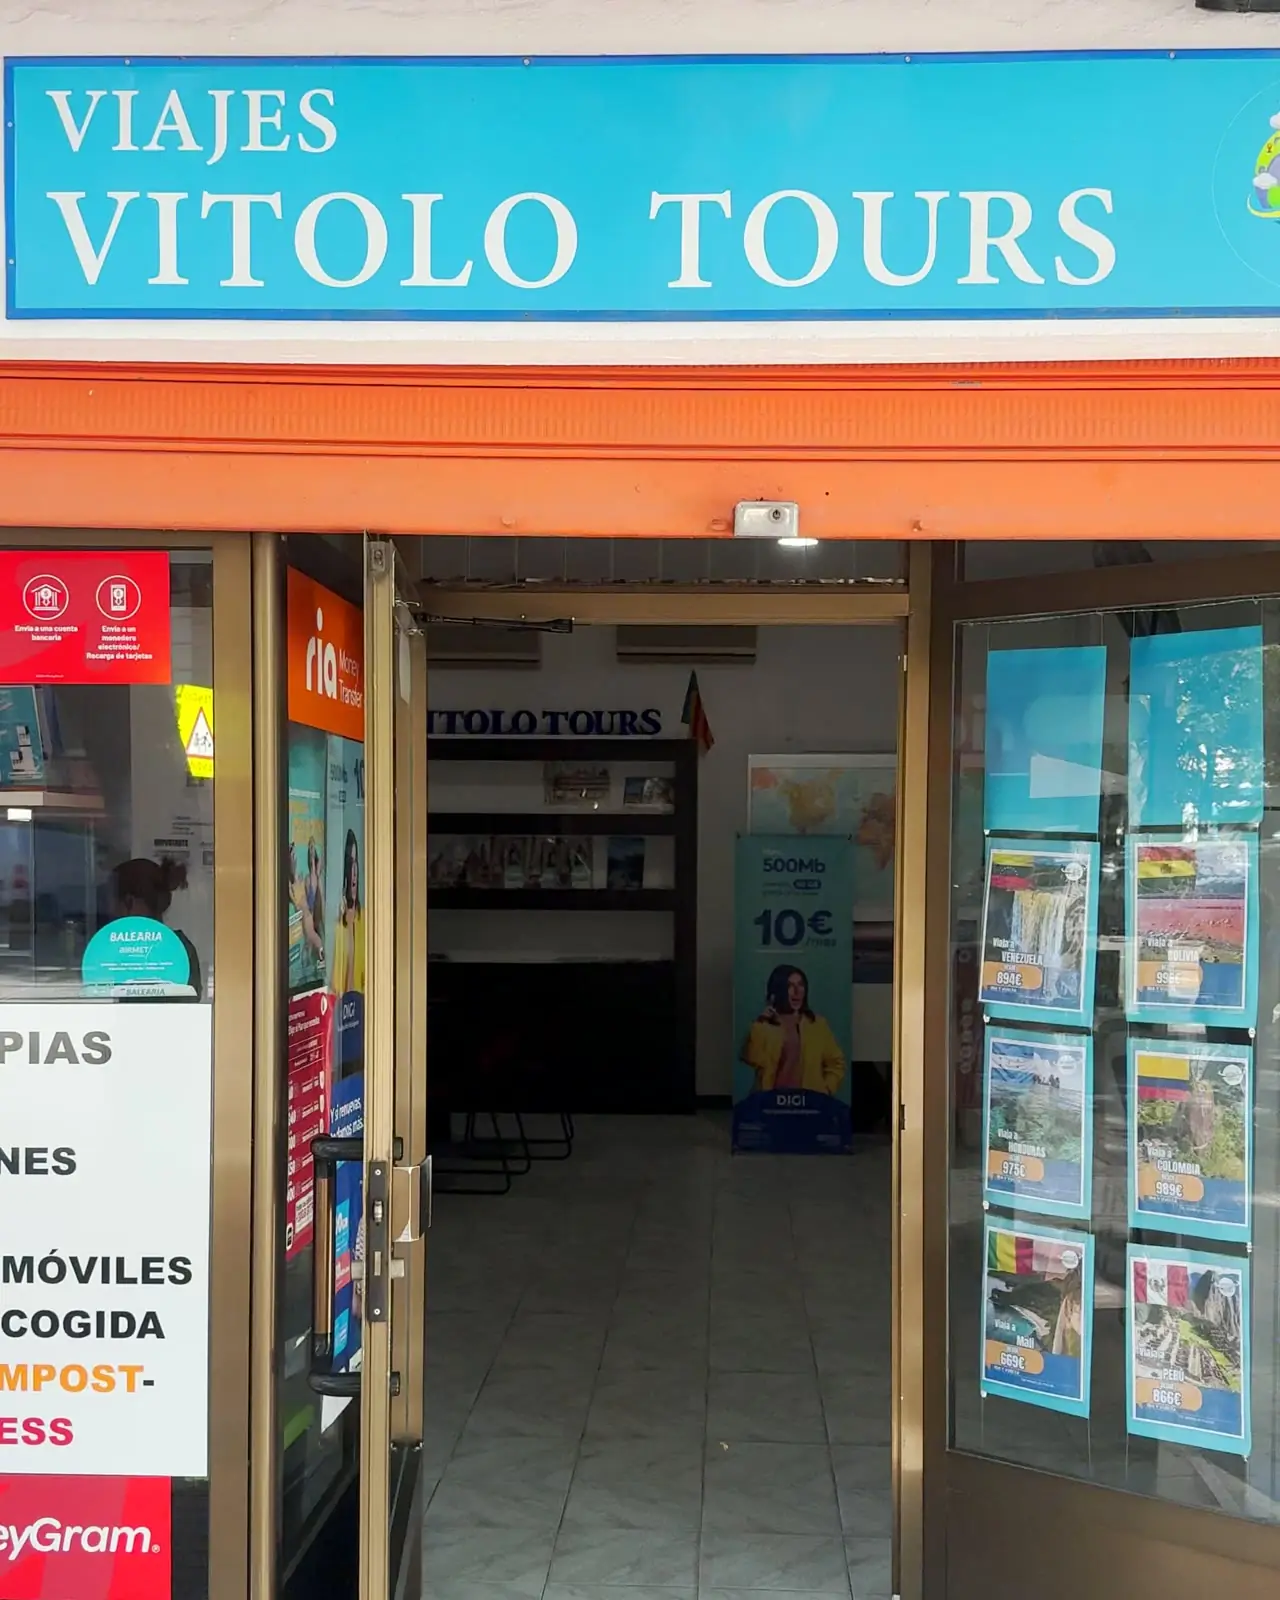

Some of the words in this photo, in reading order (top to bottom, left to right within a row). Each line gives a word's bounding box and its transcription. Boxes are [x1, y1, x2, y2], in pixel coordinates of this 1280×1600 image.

[46, 89, 337, 165] VIAJES
[46, 191, 578, 289] VITOLO
[649, 188, 1117, 288] TOURS
[305, 607, 337, 700] ria
[339, 649, 360, 684] Money
[338, 678, 363, 708] Transfer
[542, 708, 662, 736] TOURS
[763, 857, 826, 873] 500Mb
[1001, 951, 1043, 966] VENEZUELA
[343, 1001, 356, 1020] DIGI
[0, 1031, 112, 1065] PIAS
[776, 1094, 806, 1107] DIGI
[0, 1147, 77, 1176] NES
[1157, 1159, 1201, 1175] COLOMBIA
[1156, 1181, 1183, 1197] 989€
[2, 1249, 192, 1285] MÓVILES
[1, 1309, 165, 1339] COGIDA
[1016, 1335, 1035, 1349] Mali
[1000, 1352, 1025, 1370] 669€
[0, 1363, 154, 1393] MPOST-
[0, 1417, 74, 1446] ESS
